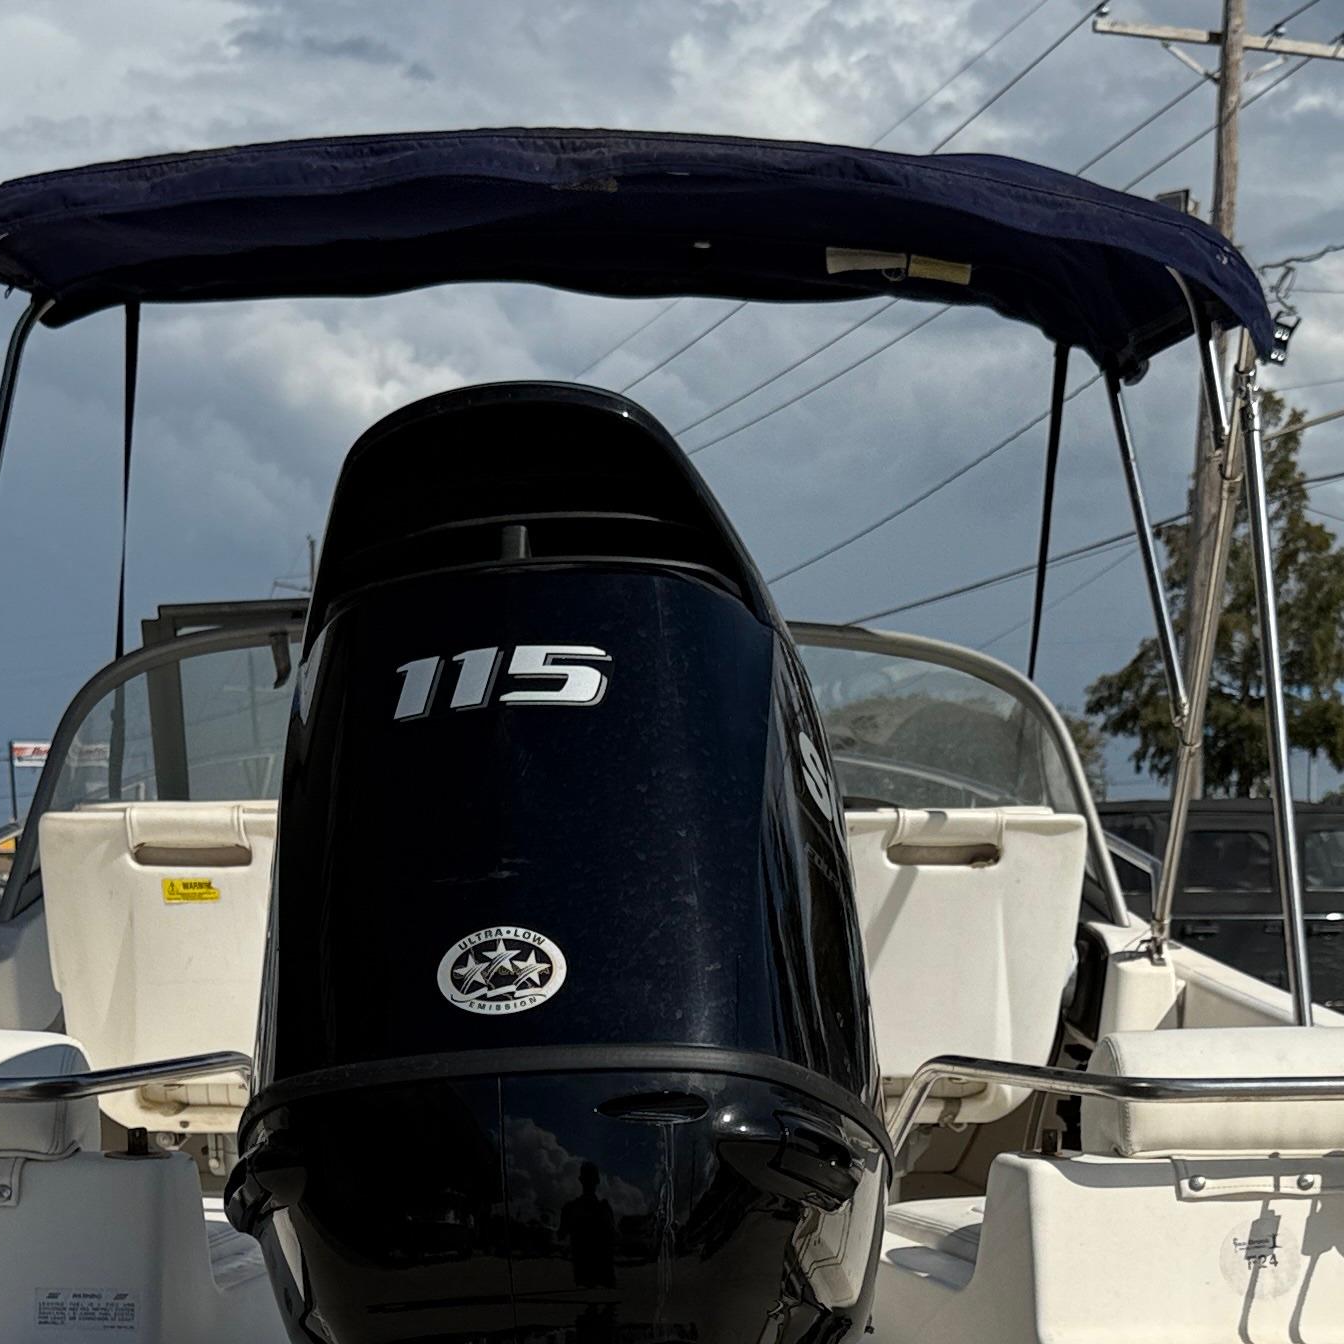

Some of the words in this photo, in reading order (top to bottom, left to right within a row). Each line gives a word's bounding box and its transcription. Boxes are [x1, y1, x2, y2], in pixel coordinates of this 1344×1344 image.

[394, 646, 613, 722] 115
[457, 928, 504, 951] ULTRA
[513, 928, 546, 946] LOW
[468, 996, 537, 1012] EMISSION
